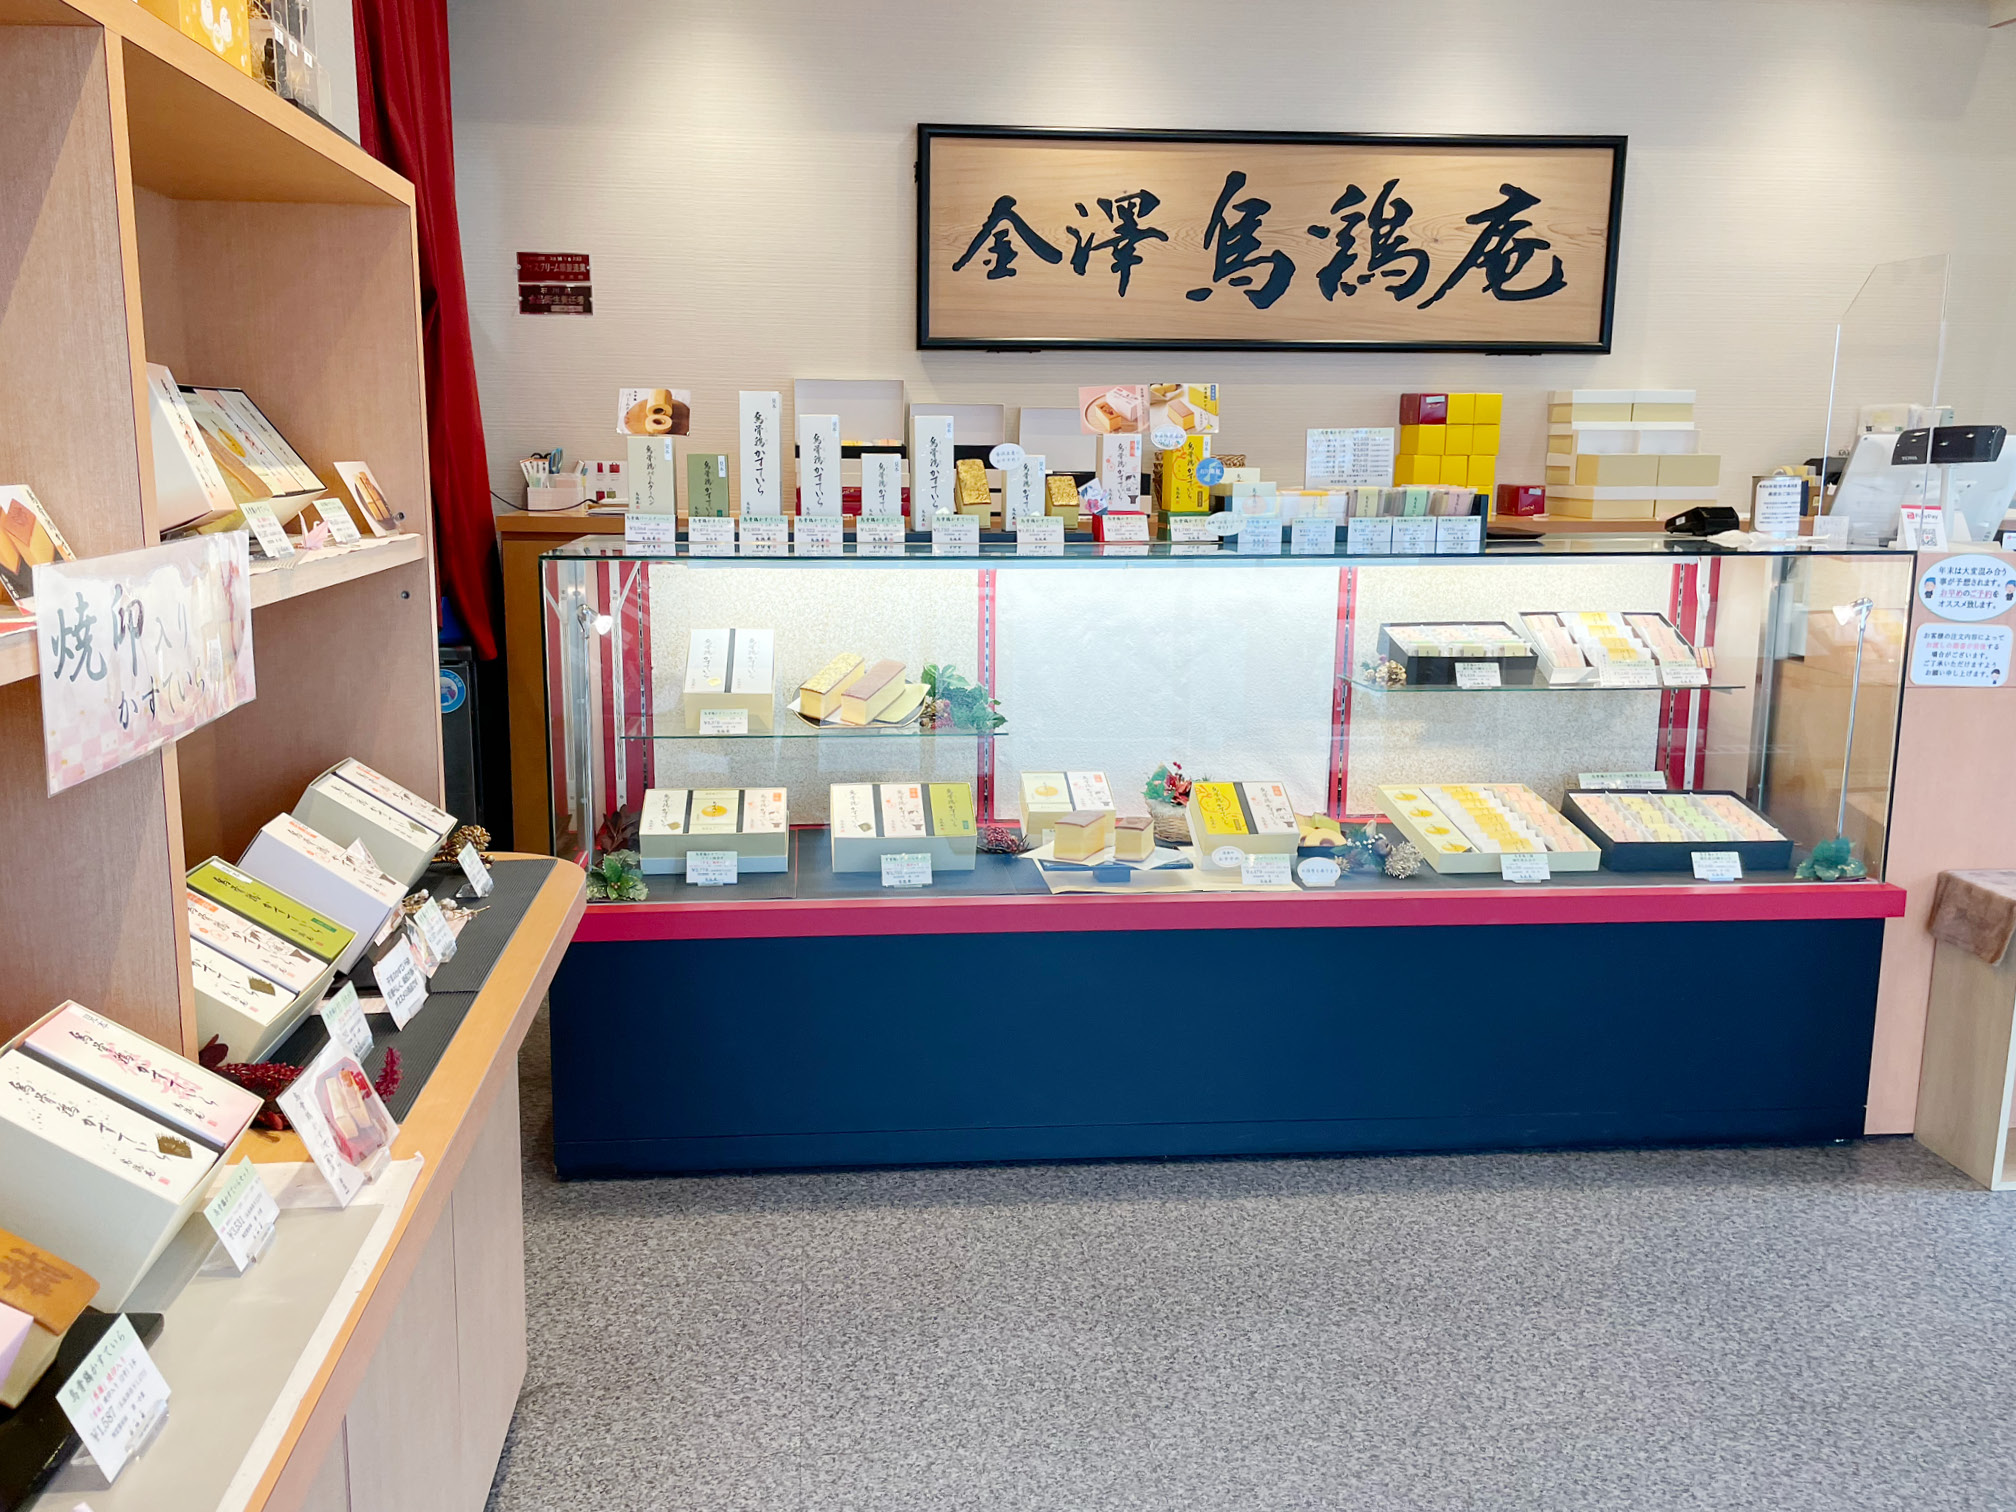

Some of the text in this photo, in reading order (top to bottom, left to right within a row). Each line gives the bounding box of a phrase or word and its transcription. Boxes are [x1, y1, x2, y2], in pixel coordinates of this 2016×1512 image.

[754, 411, 766, 496] 烏骨鶏かすていら
[812, 433, 824, 507] 烏骨鶏かすていら
[930, 436, 940, 508] 烏骨鶏かすていら
[1938, 600, 1997, 610] オススメ致します。
[1939, 566, 2008, 576] 年末は大変混み合う
[1940, 578, 2001, 587] 事が予想されます。
[51, 583, 189, 684] 焼印入り
[68, 1030, 219, 1108] 烏骨鶏かすていら
[8, 1079, 173, 1163] 烏骨鶏かすていら
[68, 1330, 126, 1404] 烏骨鶏かすていら
[89, 1406, 118, 1443] ¥1,587
